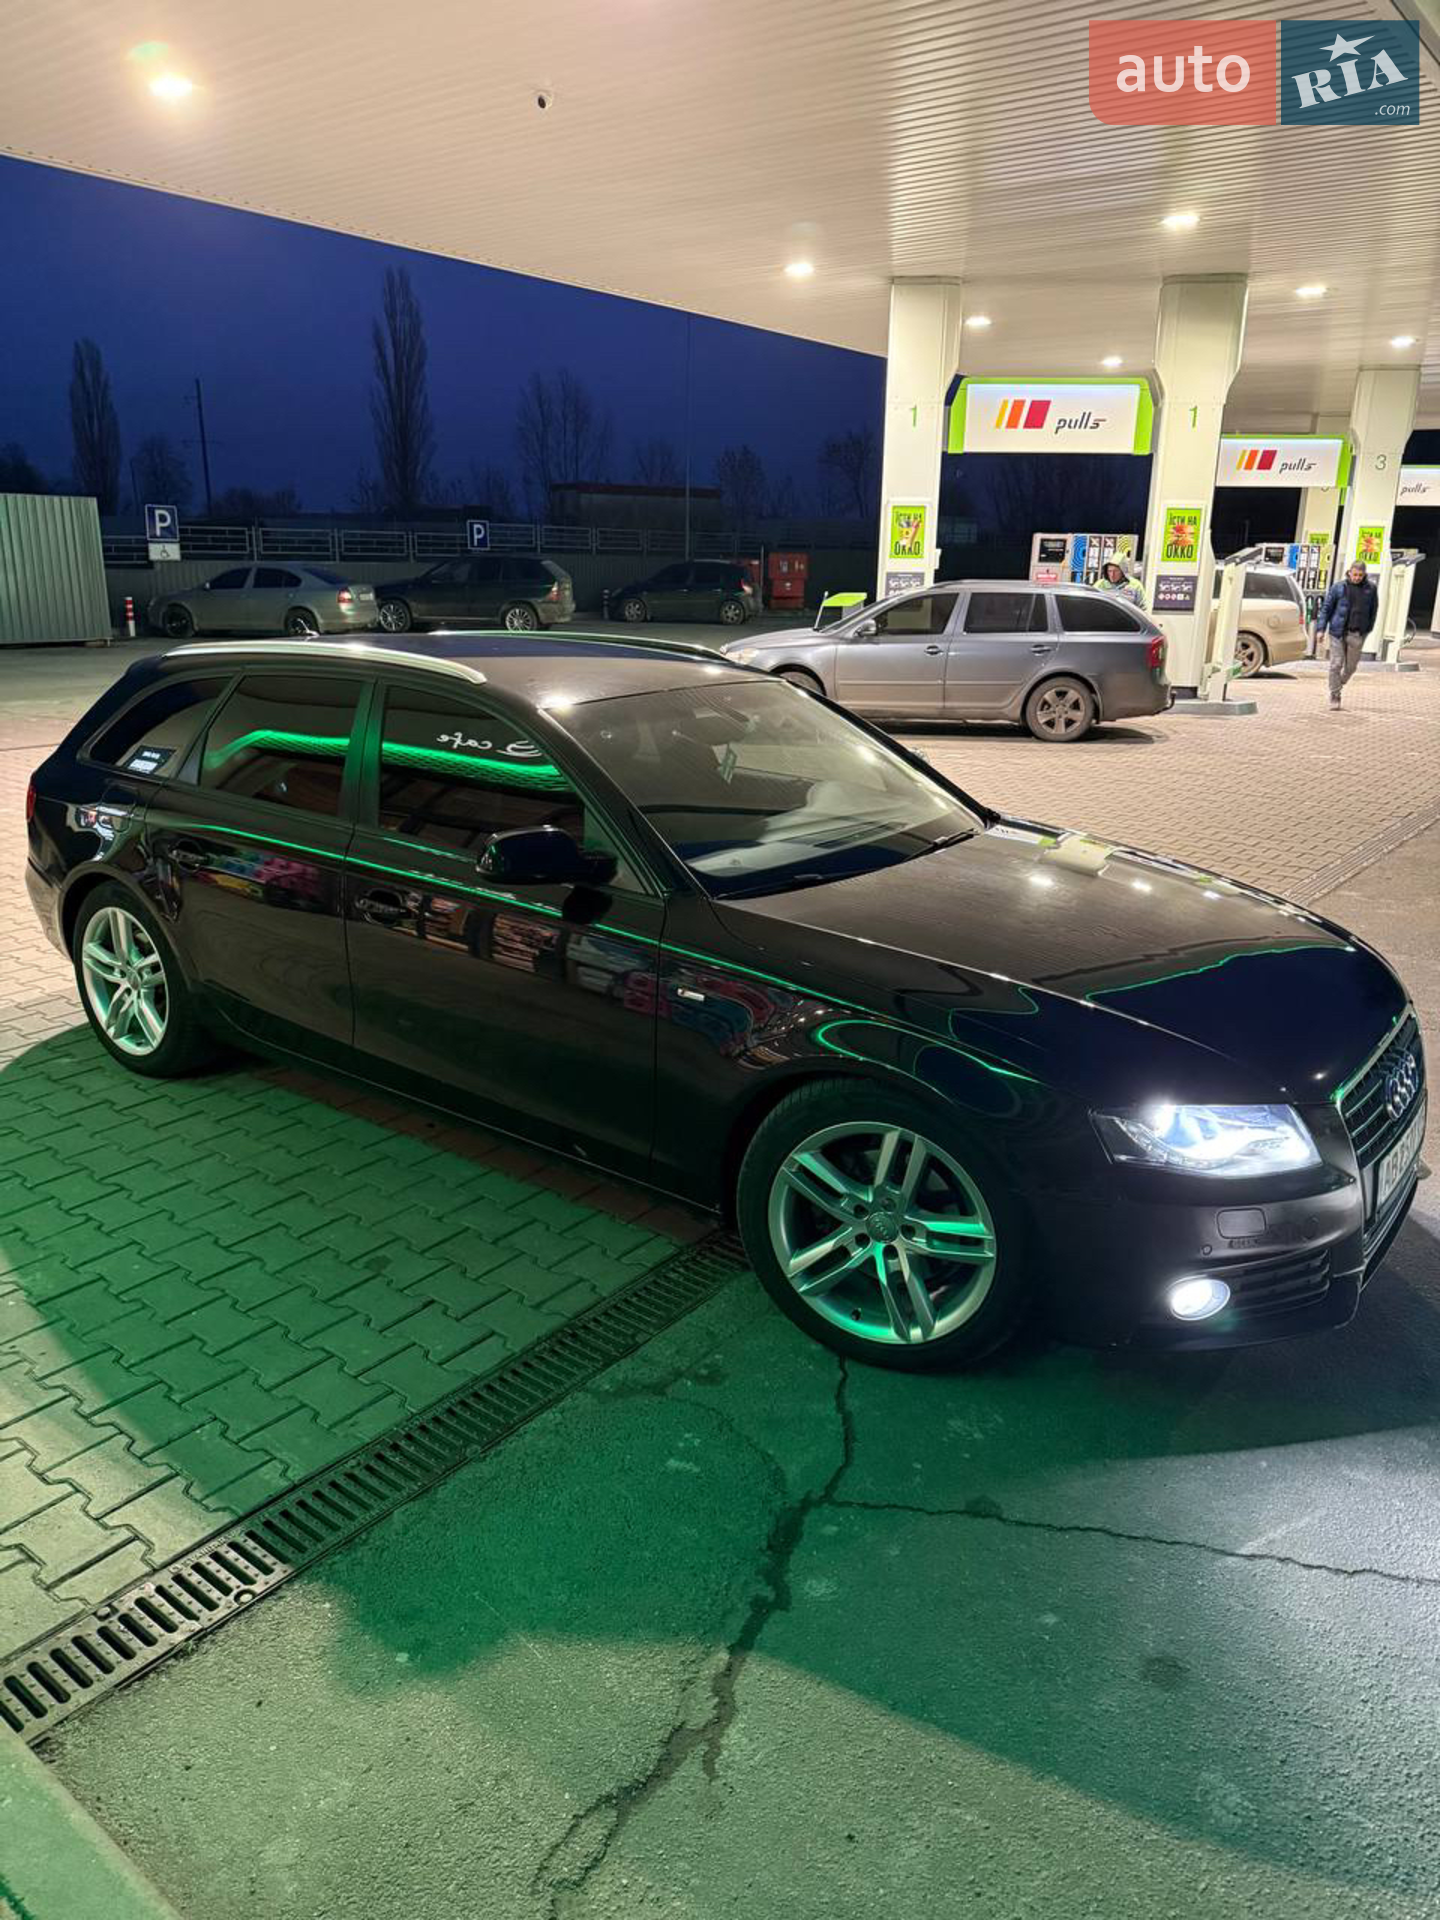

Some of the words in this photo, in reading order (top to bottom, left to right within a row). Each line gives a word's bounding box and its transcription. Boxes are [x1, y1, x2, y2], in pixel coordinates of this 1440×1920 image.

[909, 404, 917, 428] 1
[1054, 411, 1107, 435] pulls
[1189, 405, 1198, 428] 1
[1279, 458, 1317, 474] pulls
[1375, 454, 1387, 471] 3
[1400, 483, 1432, 496] pulls
[154, 509, 171, 537] P
[473, 523, 485, 547] P
